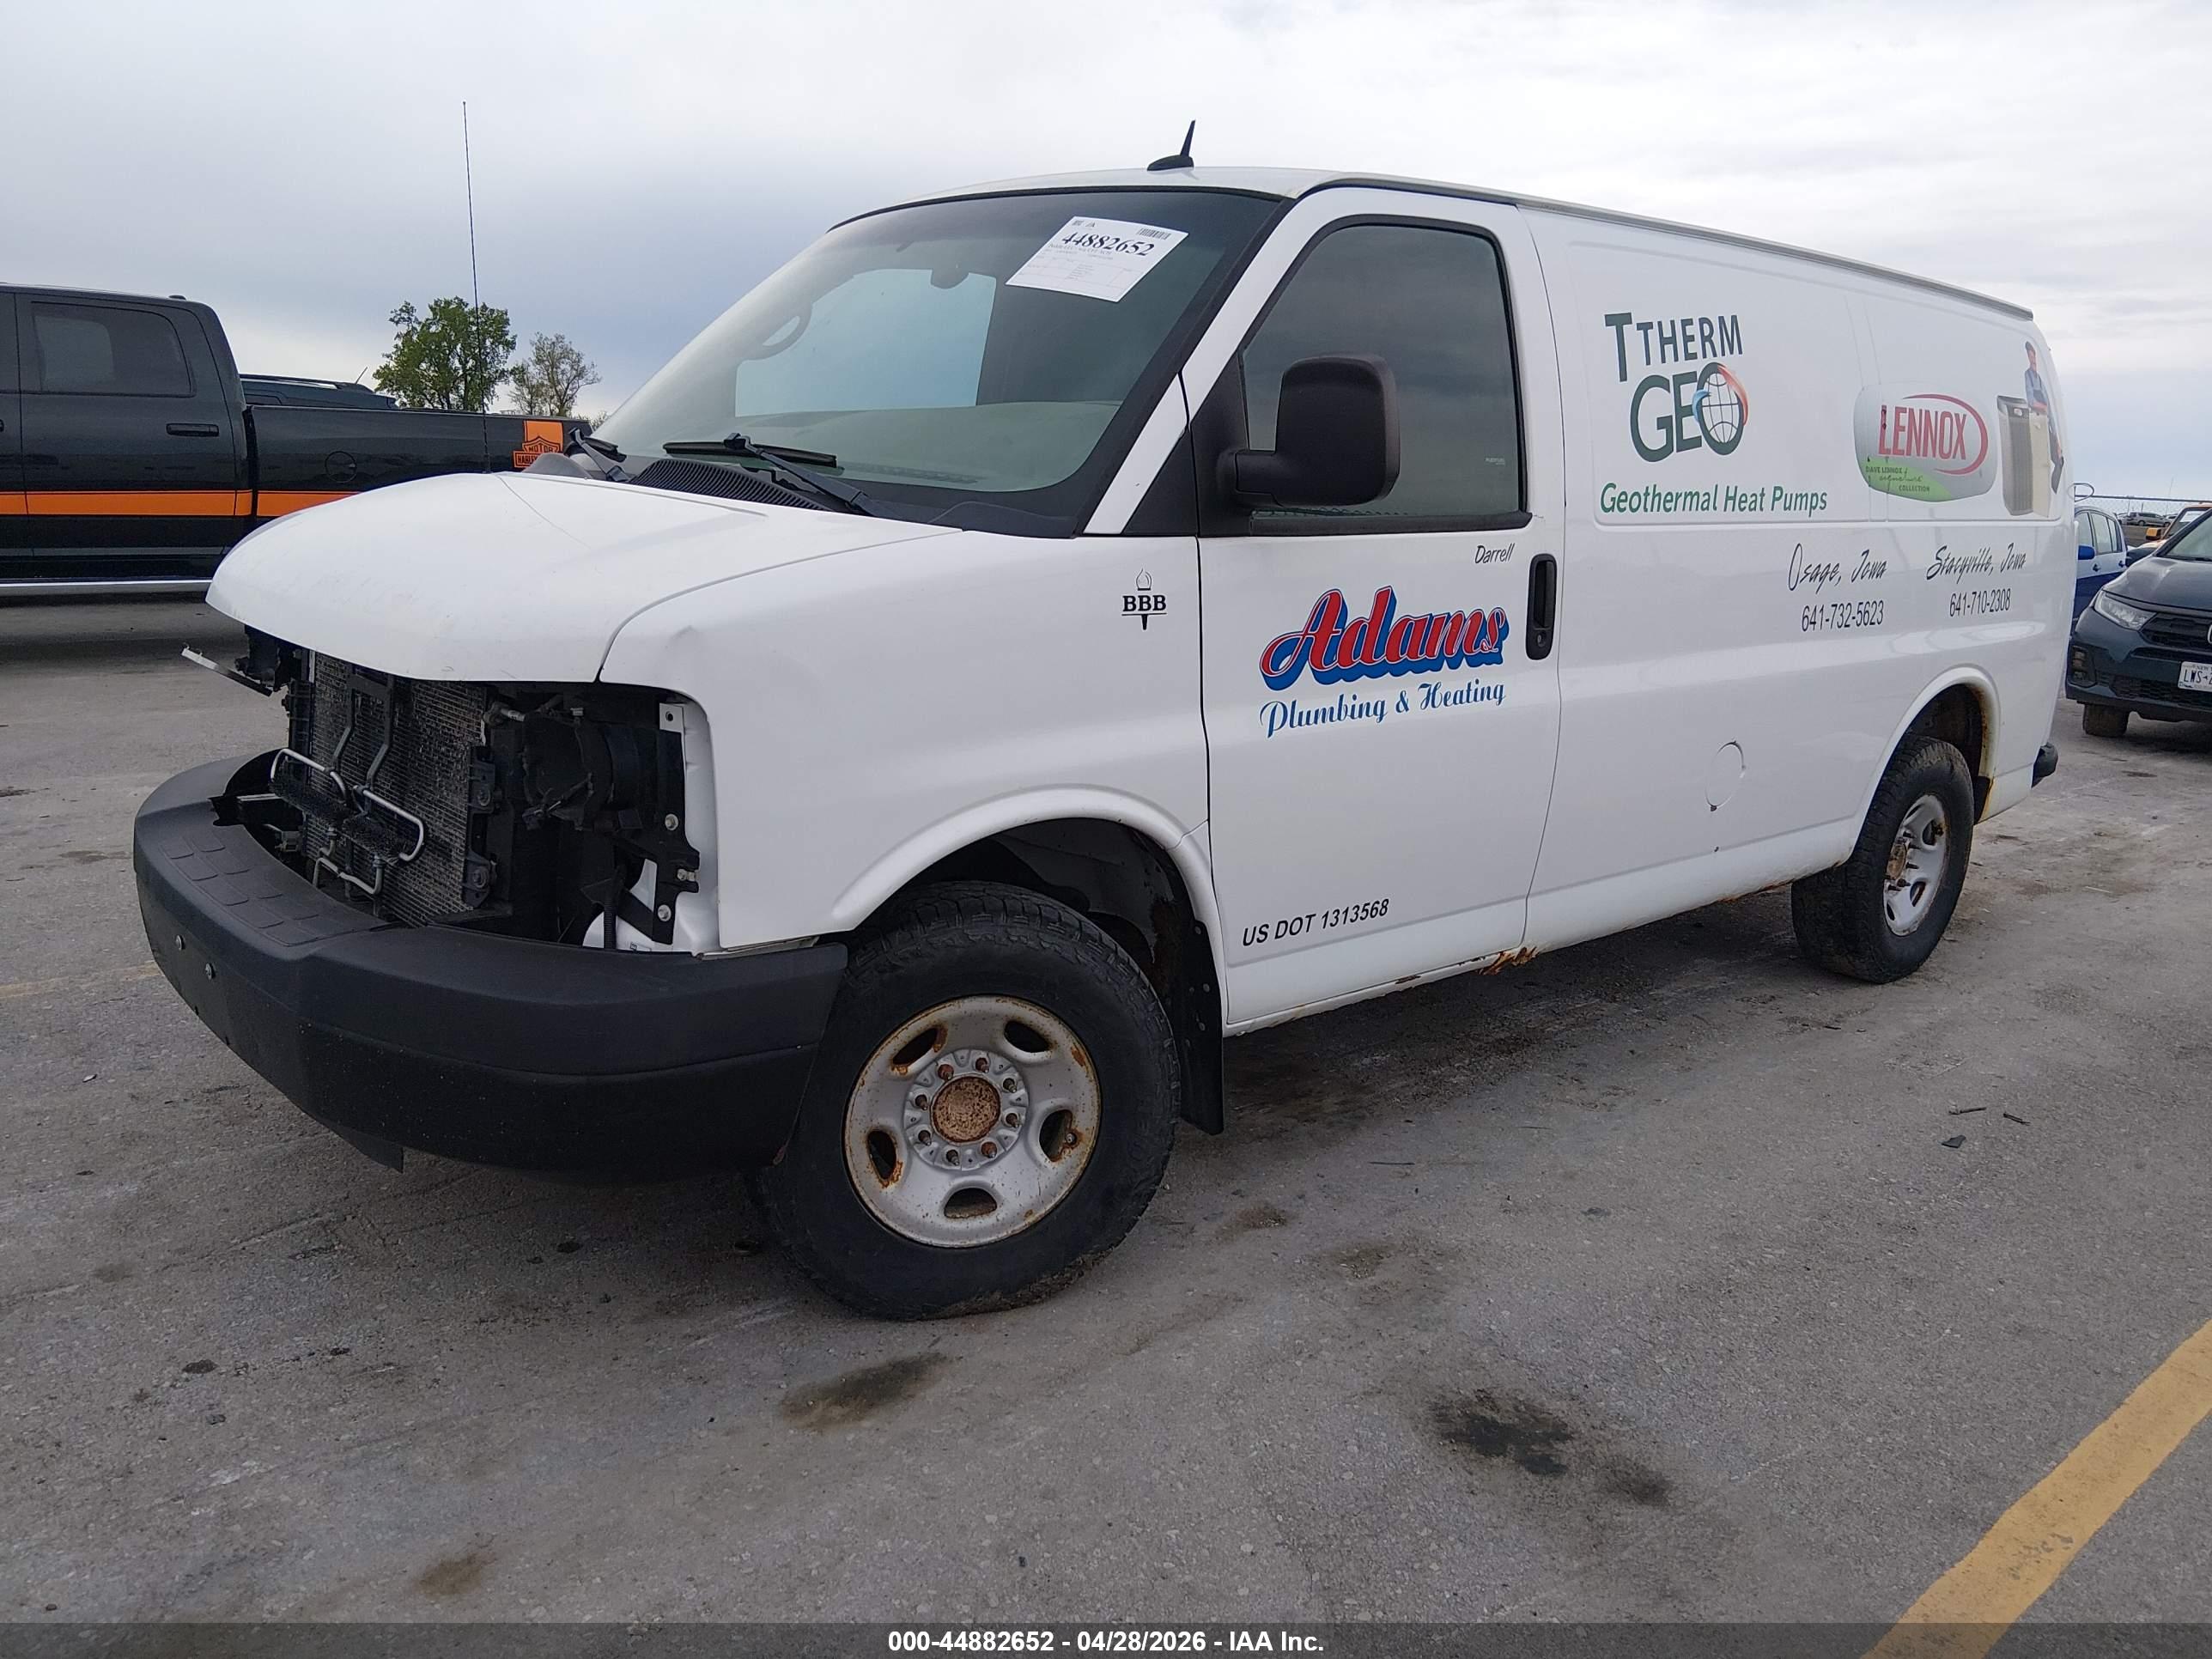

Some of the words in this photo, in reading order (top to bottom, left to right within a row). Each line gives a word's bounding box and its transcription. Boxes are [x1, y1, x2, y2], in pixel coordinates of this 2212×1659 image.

[1062, 232, 1154, 257] 44882652
[1630, 362, 1748, 463] GEO
[1878, 404, 1967, 460] LENNOX
[1600, 482, 1718, 514] Geothermal
[1723, 485, 1766, 513] Heat
[1771, 485, 1828, 518] Pumps
[1474, 542, 1516, 564] Darrell
[1122, 594, 1167, 612] BBB
[1802, 599, 1884, 632] 641-732-5623
[1948, 587, 2011, 617] 641-710-2308
[1260, 586, 1510, 690] Adams
[1260, 693, 1388, 738] Plumbing
[1395, 690, 1410, 713] &
[1417, 678, 1505, 709] Heating
[1243, 924, 1270, 946] US
[1274, 914, 1317, 940] DOT
[1321, 898, 1389, 929] 1313568
